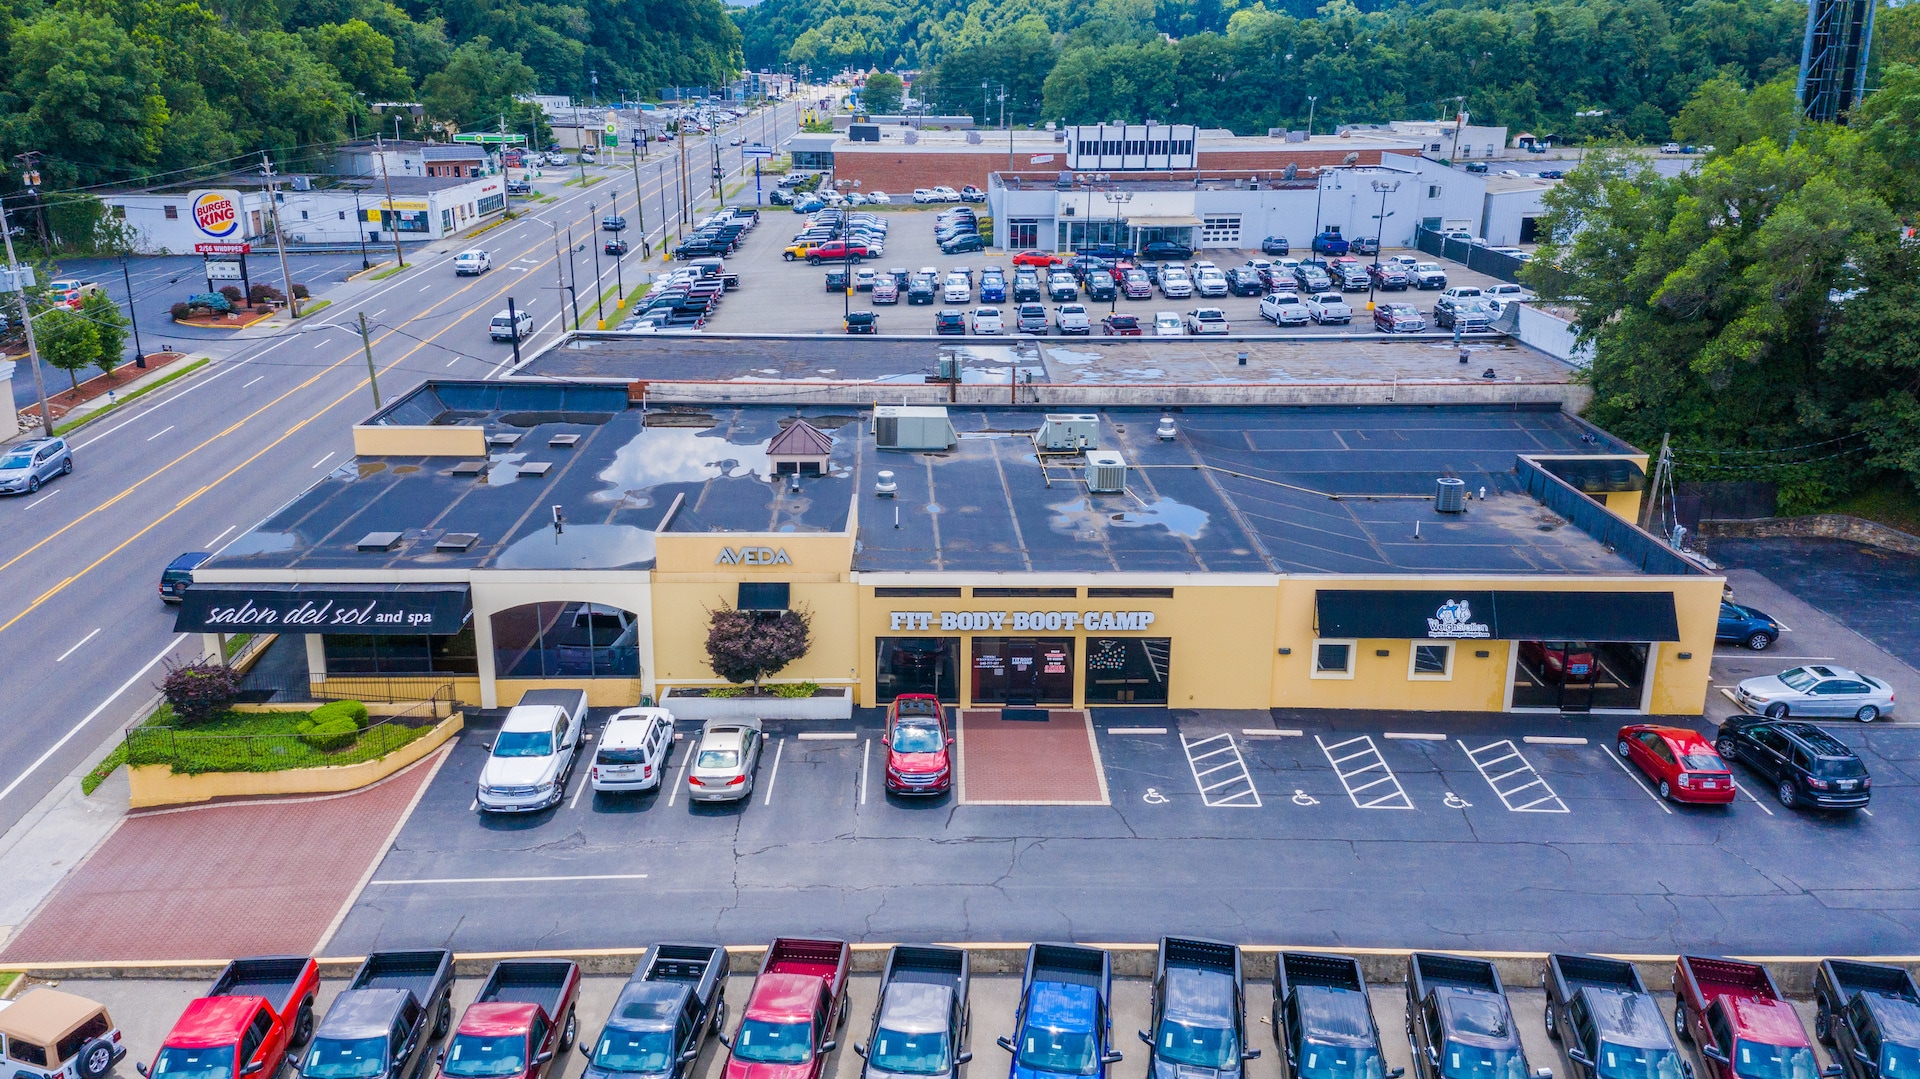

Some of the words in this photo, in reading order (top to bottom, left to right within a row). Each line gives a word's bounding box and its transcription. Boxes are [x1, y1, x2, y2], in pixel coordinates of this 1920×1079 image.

[197, 200, 232, 217] BURGER
[200, 208, 235, 228] KING
[213, 245, 243, 254] WHOPPER
[714, 546, 793, 566] AVEDA
[205, 599, 278, 624] salon
[283, 600, 333, 624] del
[330, 600, 377, 624] sol
[375, 610, 403, 623] and
[407, 611, 432, 626] spa
[890, 611, 932, 631] FIT
[941, 611, 1006, 631] BODY
[1013, 611, 1079, 631] BOOT
[1083, 611, 1155, 631] CAMP
